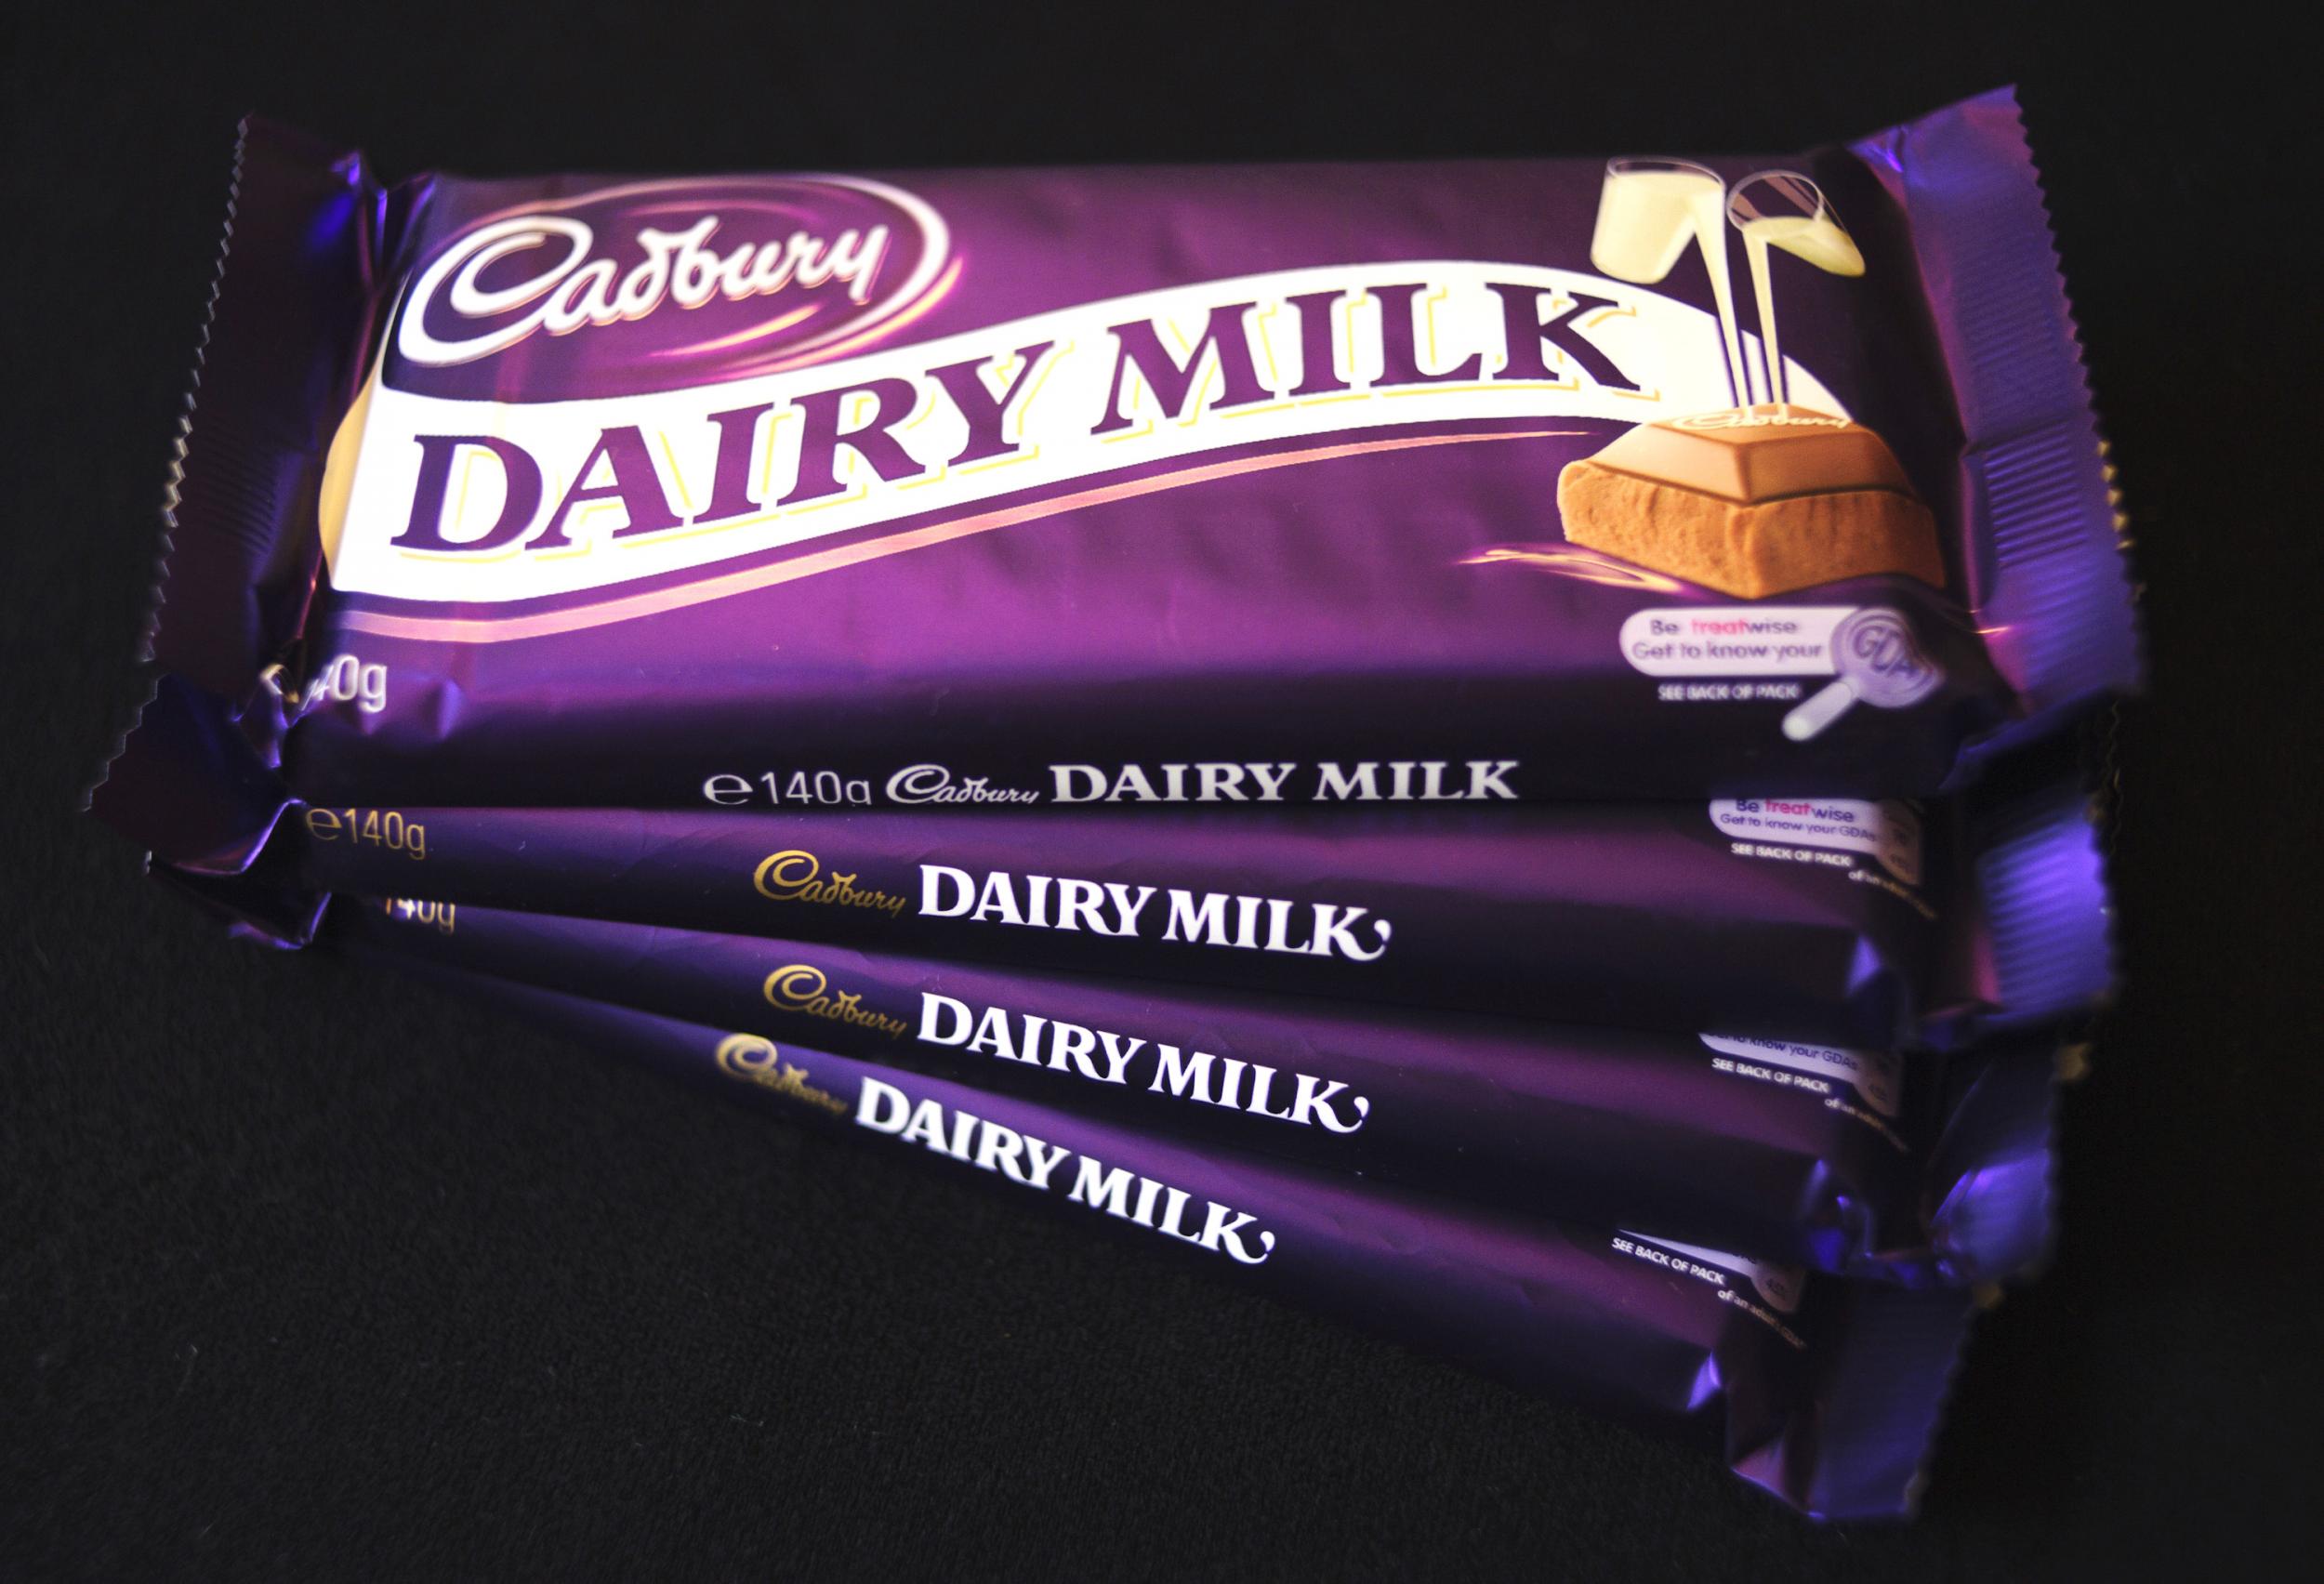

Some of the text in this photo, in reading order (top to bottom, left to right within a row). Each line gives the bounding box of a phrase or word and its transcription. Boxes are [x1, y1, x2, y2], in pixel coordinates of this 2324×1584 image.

[398, 216, 891, 363] Cadbury
[390, 281, 1642, 551] DAIRY MILK
[1650, 617, 1799, 636] Be treatwise
[1632, 640, 1822, 663] Get to know your
[1657, 683, 1801, 701] SEE BACK OF PACK
[885, 763, 1039, 804] Cadbury
[1048, 761, 1297, 803] DAIRY
[1312, 760, 1520, 801] MILK
[1720, 813, 1745, 825] Get
[1748, 813, 1762, 827] to
[1765, 817, 1803, 832] know
[1805, 824, 1836, 836] your
[1736, 799, 1855, 824] Be treatwise
[1731, 842, 1854, 867] SEE BACK OF PACK
[753, 850, 1392, 961] Cadbury DAIRY MILK
[763, 963, 1371, 1134] Cadbury DAIRY MILK
[1789, 1043, 1819, 1057] your
[1711, 1057, 1830, 1094] SEE BACK OF PACK
[714, 1033, 1277, 1265] Cadbury DAIRY MILK
[1612, 1237, 1726, 1287] SEE BACK OF PACK
[1717, 1288, 1735, 1302] of
